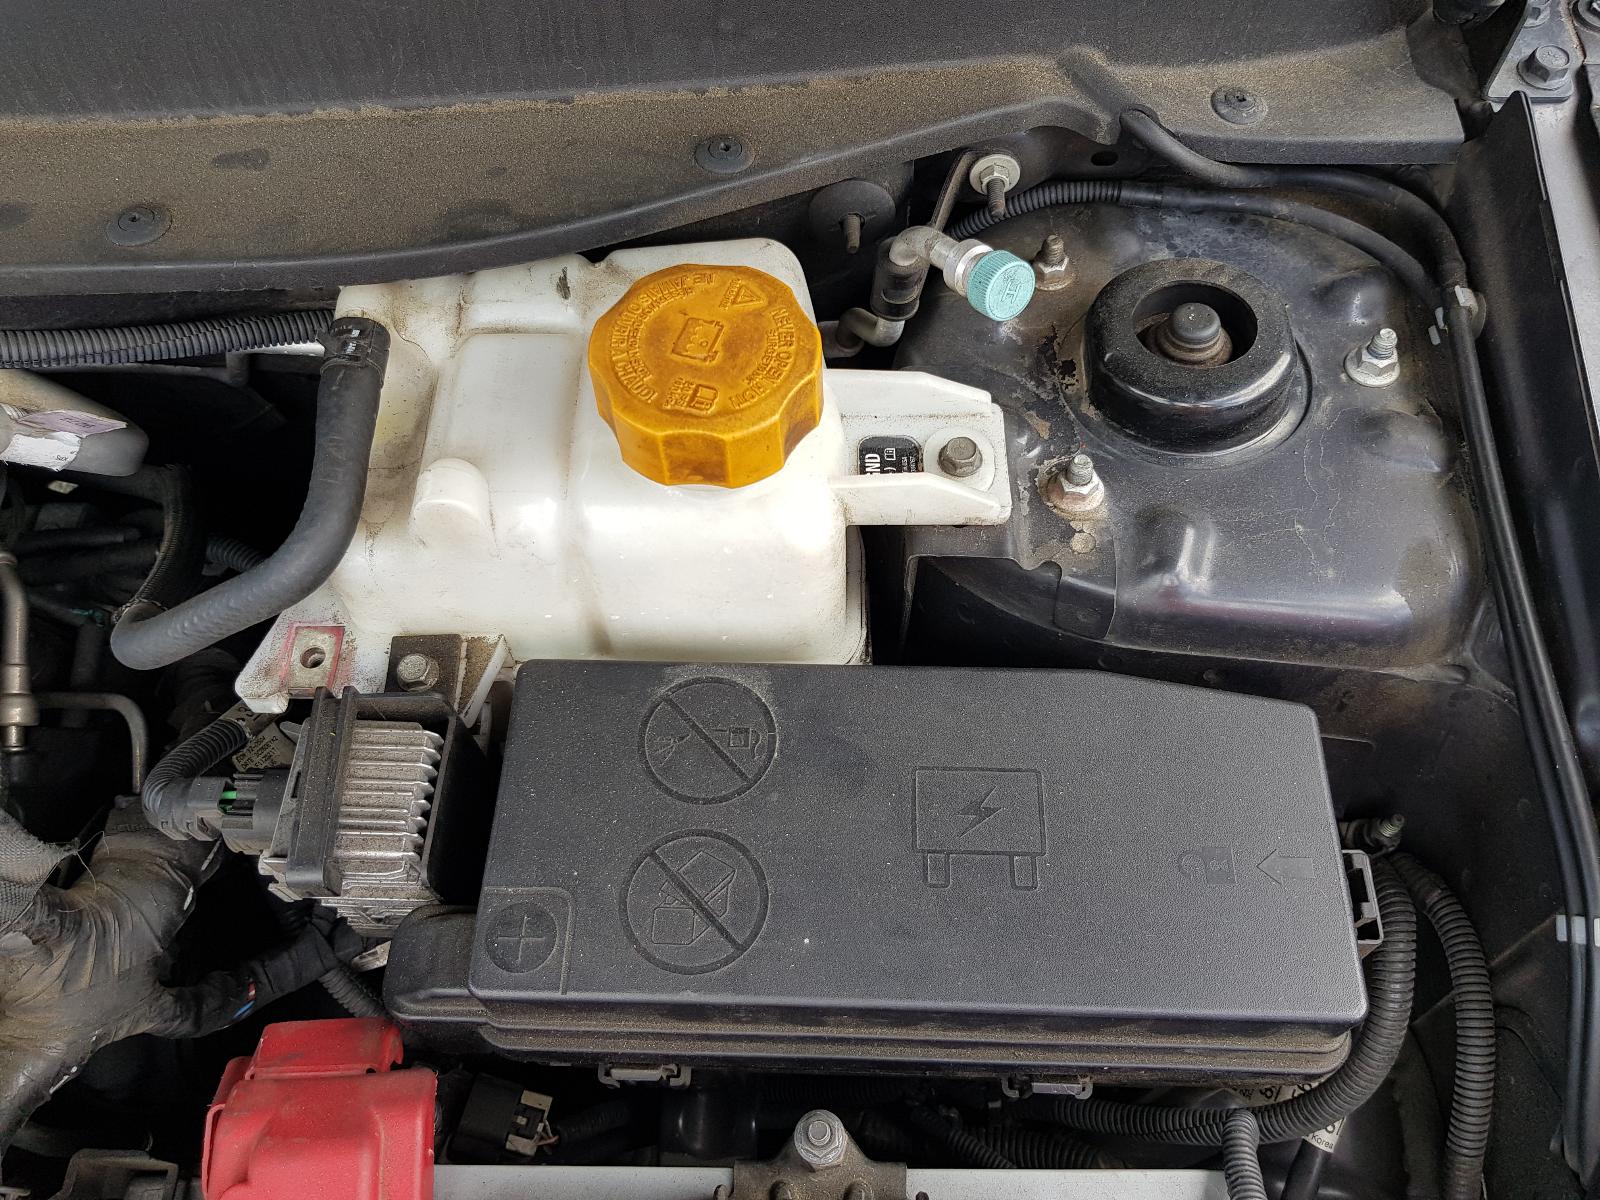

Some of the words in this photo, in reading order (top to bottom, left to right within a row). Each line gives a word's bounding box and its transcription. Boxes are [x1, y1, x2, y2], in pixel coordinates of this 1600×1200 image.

[770, 307, 796, 349] NEVER
[763, 349, 794, 387] OPEN
[865, 453, 881, 474] ND
